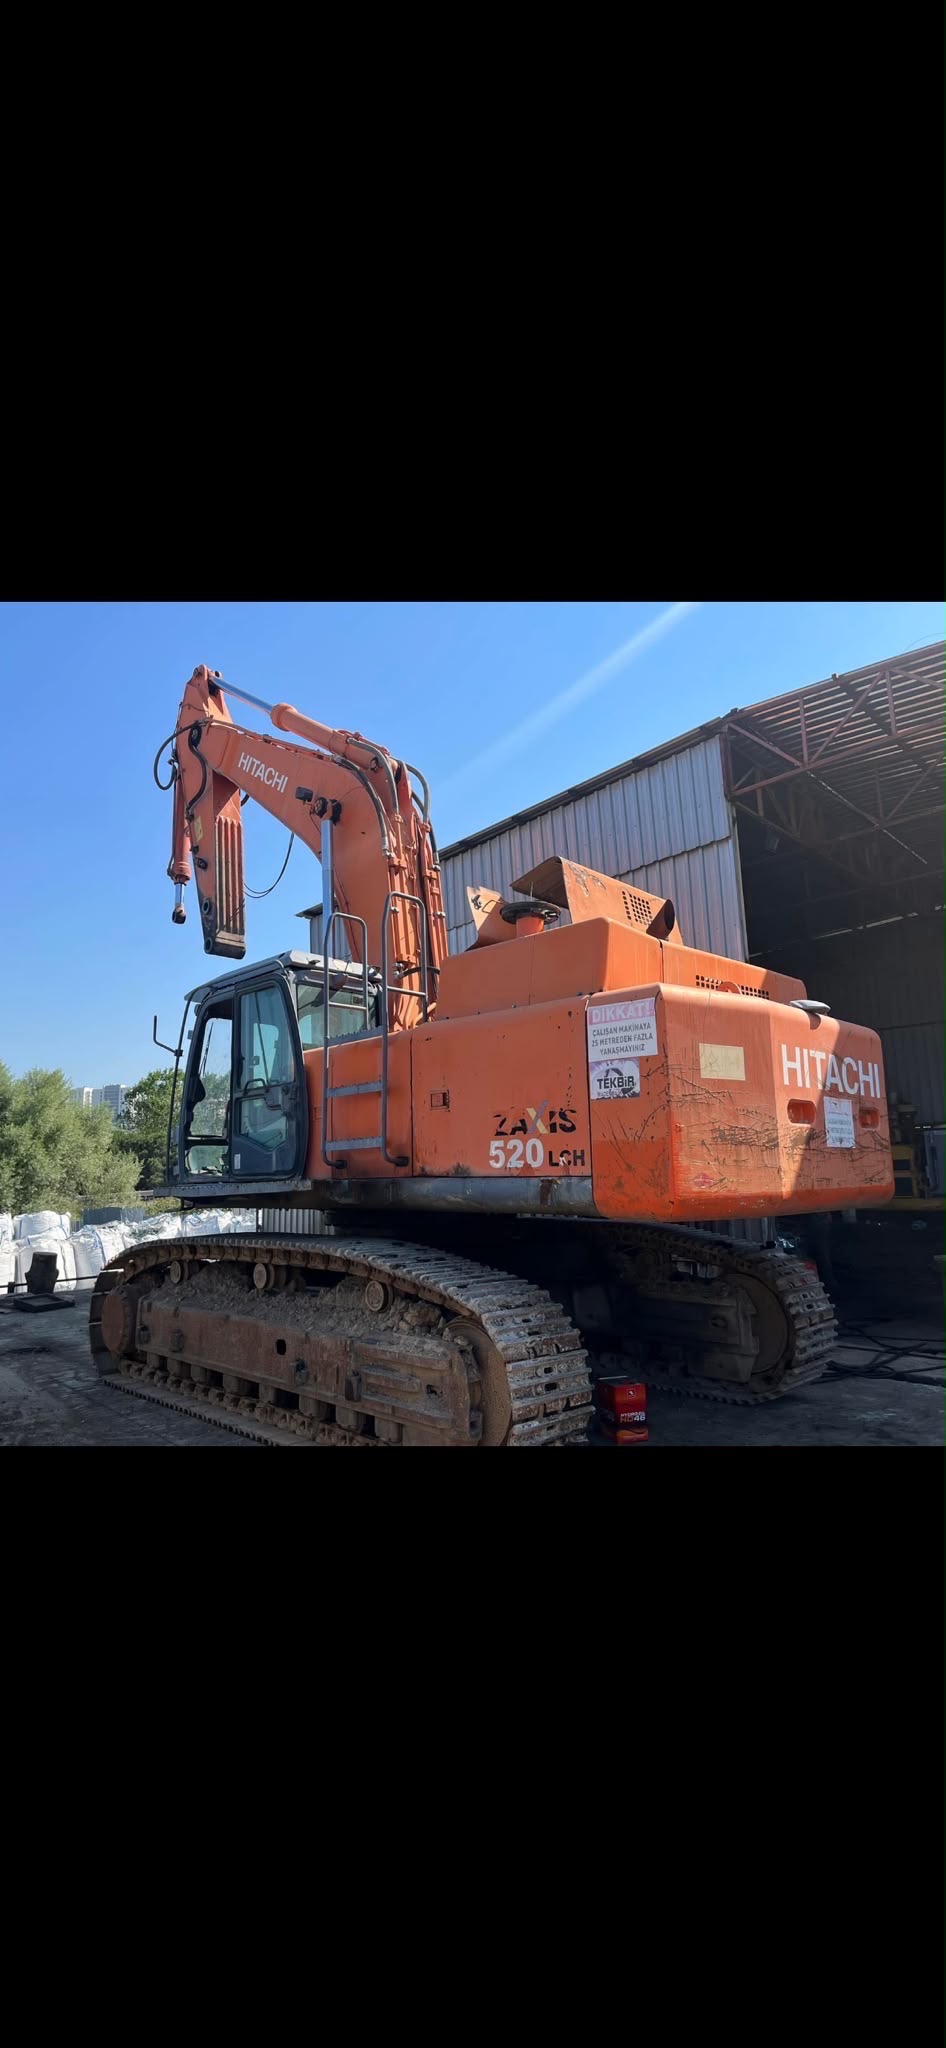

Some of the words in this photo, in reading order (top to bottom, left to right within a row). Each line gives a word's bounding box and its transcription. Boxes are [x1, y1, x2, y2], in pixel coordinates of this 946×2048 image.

[238, 752, 288, 792] HITACHI
[592, 1039, 599, 1047] 25
[600, 1035, 633, 1046] METREDEN
[634, 1032, 653, 1042] FAZLA
[593, 1027, 618, 1037] ÇALIŞAN
[619, 1022, 651, 1033] MAKİNAYA
[599, 1044, 645, 1056] YANAŞMAYINIZ
[781, 1043, 881, 1098] HITACHI
[489, 1138, 544, 1169] 520
[548, 1149, 585, 1167] LCH
